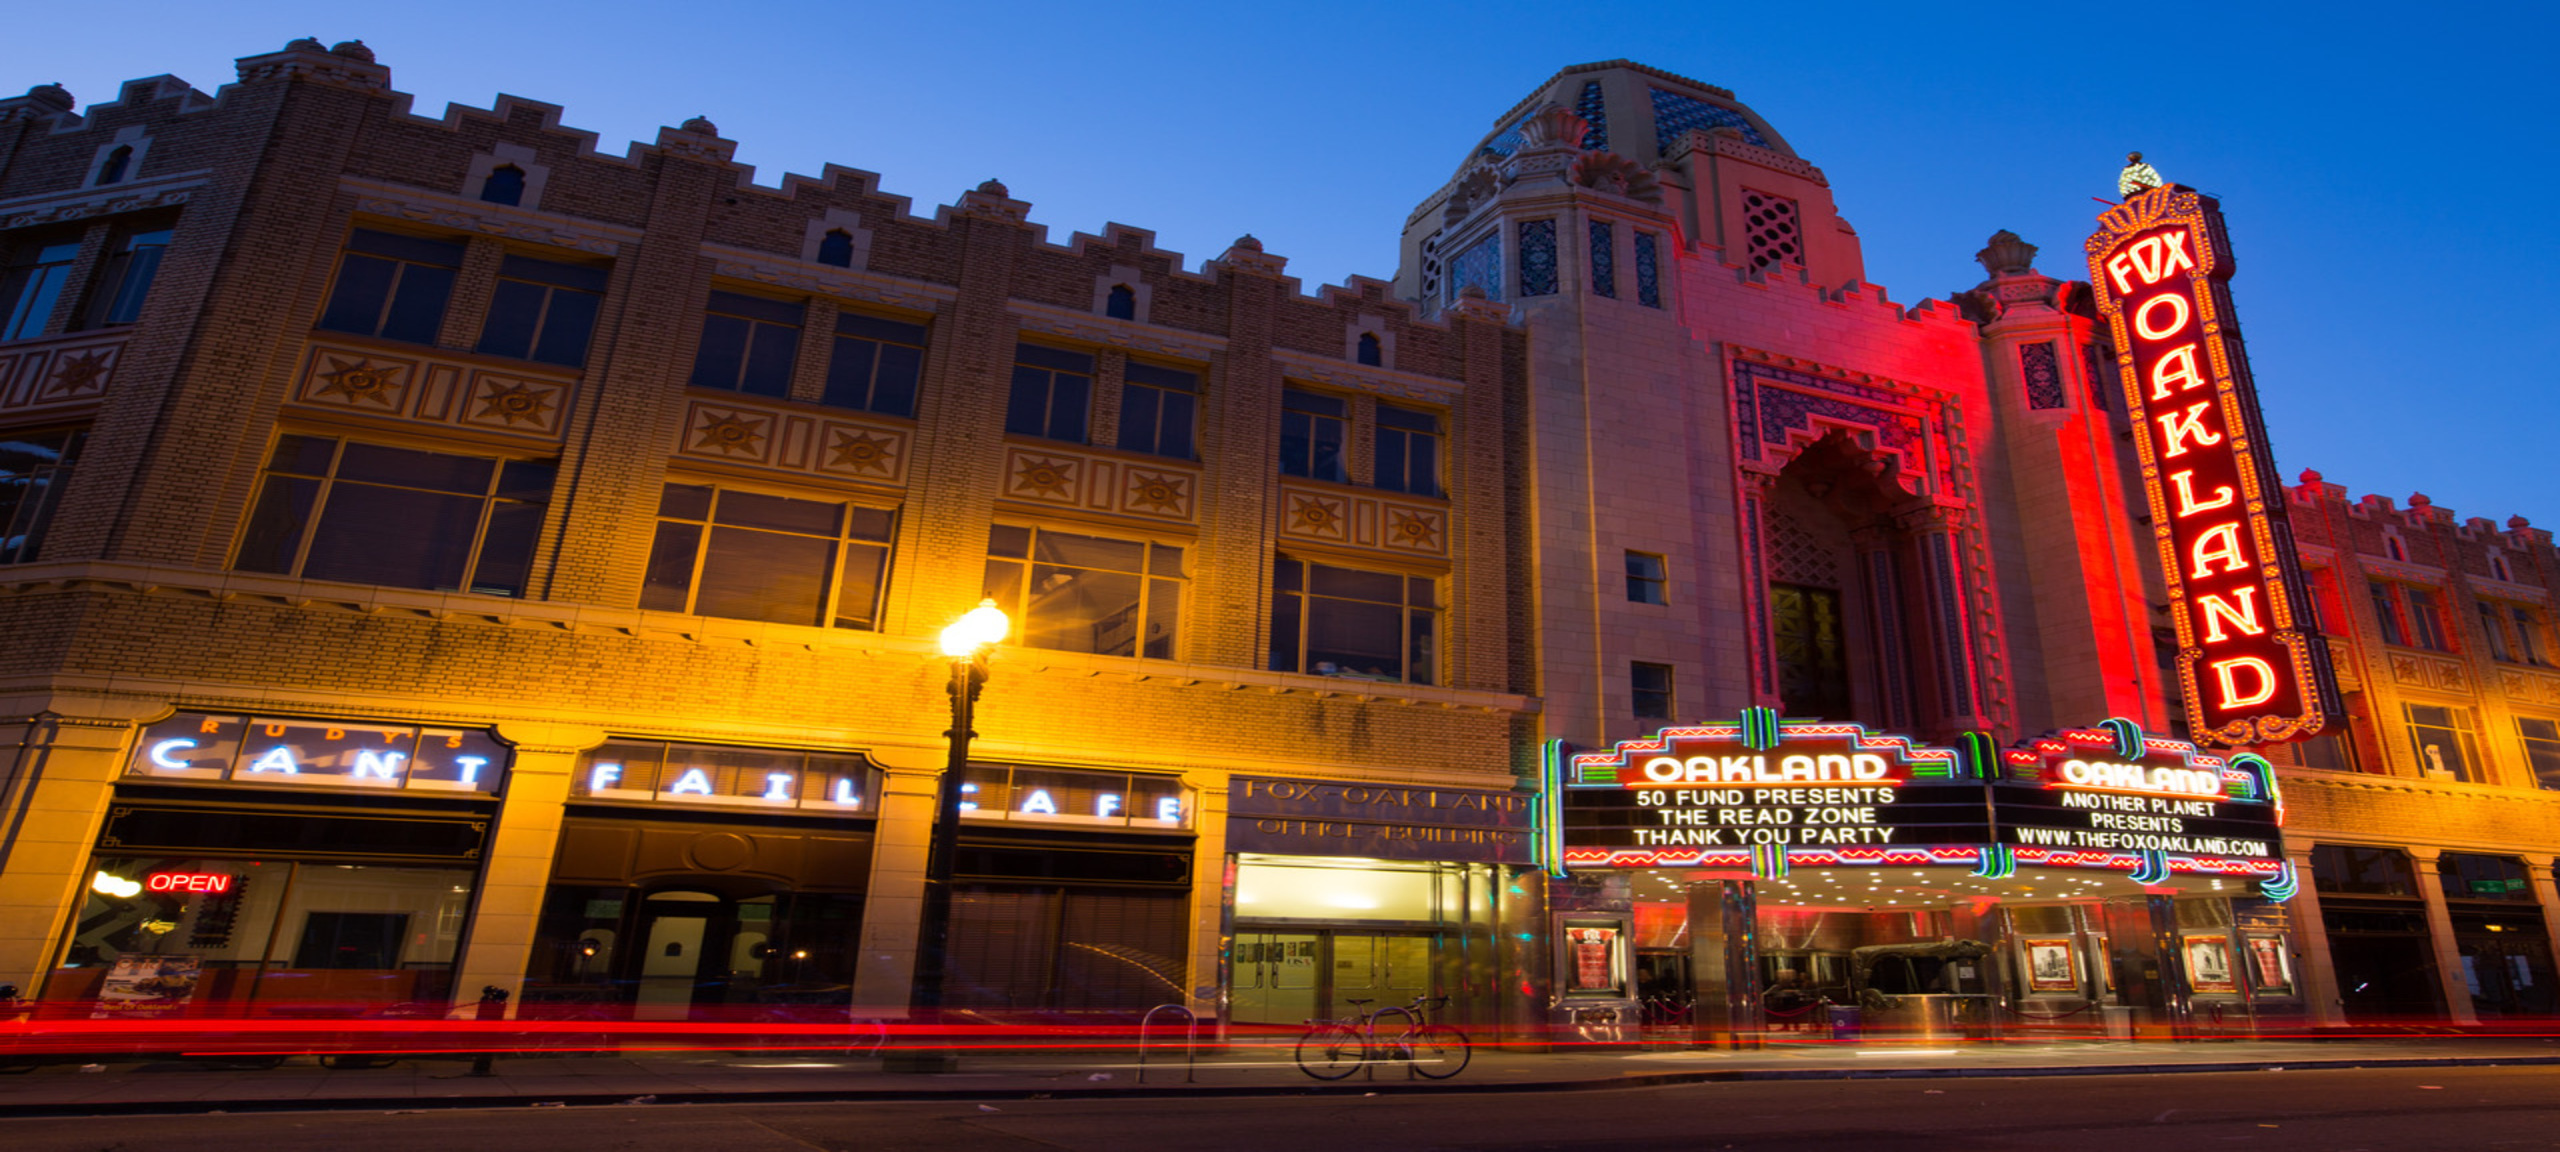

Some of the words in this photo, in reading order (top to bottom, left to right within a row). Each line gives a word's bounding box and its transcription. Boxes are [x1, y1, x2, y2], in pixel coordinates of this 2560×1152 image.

[2107, 231, 2194, 294] FOX
[2135, 293, 2276, 710] OAKLAND
[200, 720, 462, 749] RUDY'S
[1644, 754, 1888, 782] OAKLAND
[2061, 760, 2221, 795] OAKLAND
[590, 763, 860, 805] FAIL
[1637, 790, 1667, 806] 50
[1676, 789, 1744, 806] FUND
[1755, 787, 1895, 805] PRESENTS
[1658, 809, 1709, 826] THE
[1719, 808, 1793, 825] READ
[1804, 807, 1877, 824] ZONE
[2062, 791, 2147, 812] ANOTHER
[2152, 798, 2216, 817] PLANET
[1633, 828, 1722, 846] THANK
[1734, 828, 1790, 846] YOU
[1801, 826, 1895, 845] PARTY
[2090, 812, 2183, 833] PRESENTS
[2016, 827, 2268, 857] WWW.THEFOXOAKLAND.COM
[150, 874, 228, 891] OPEN
